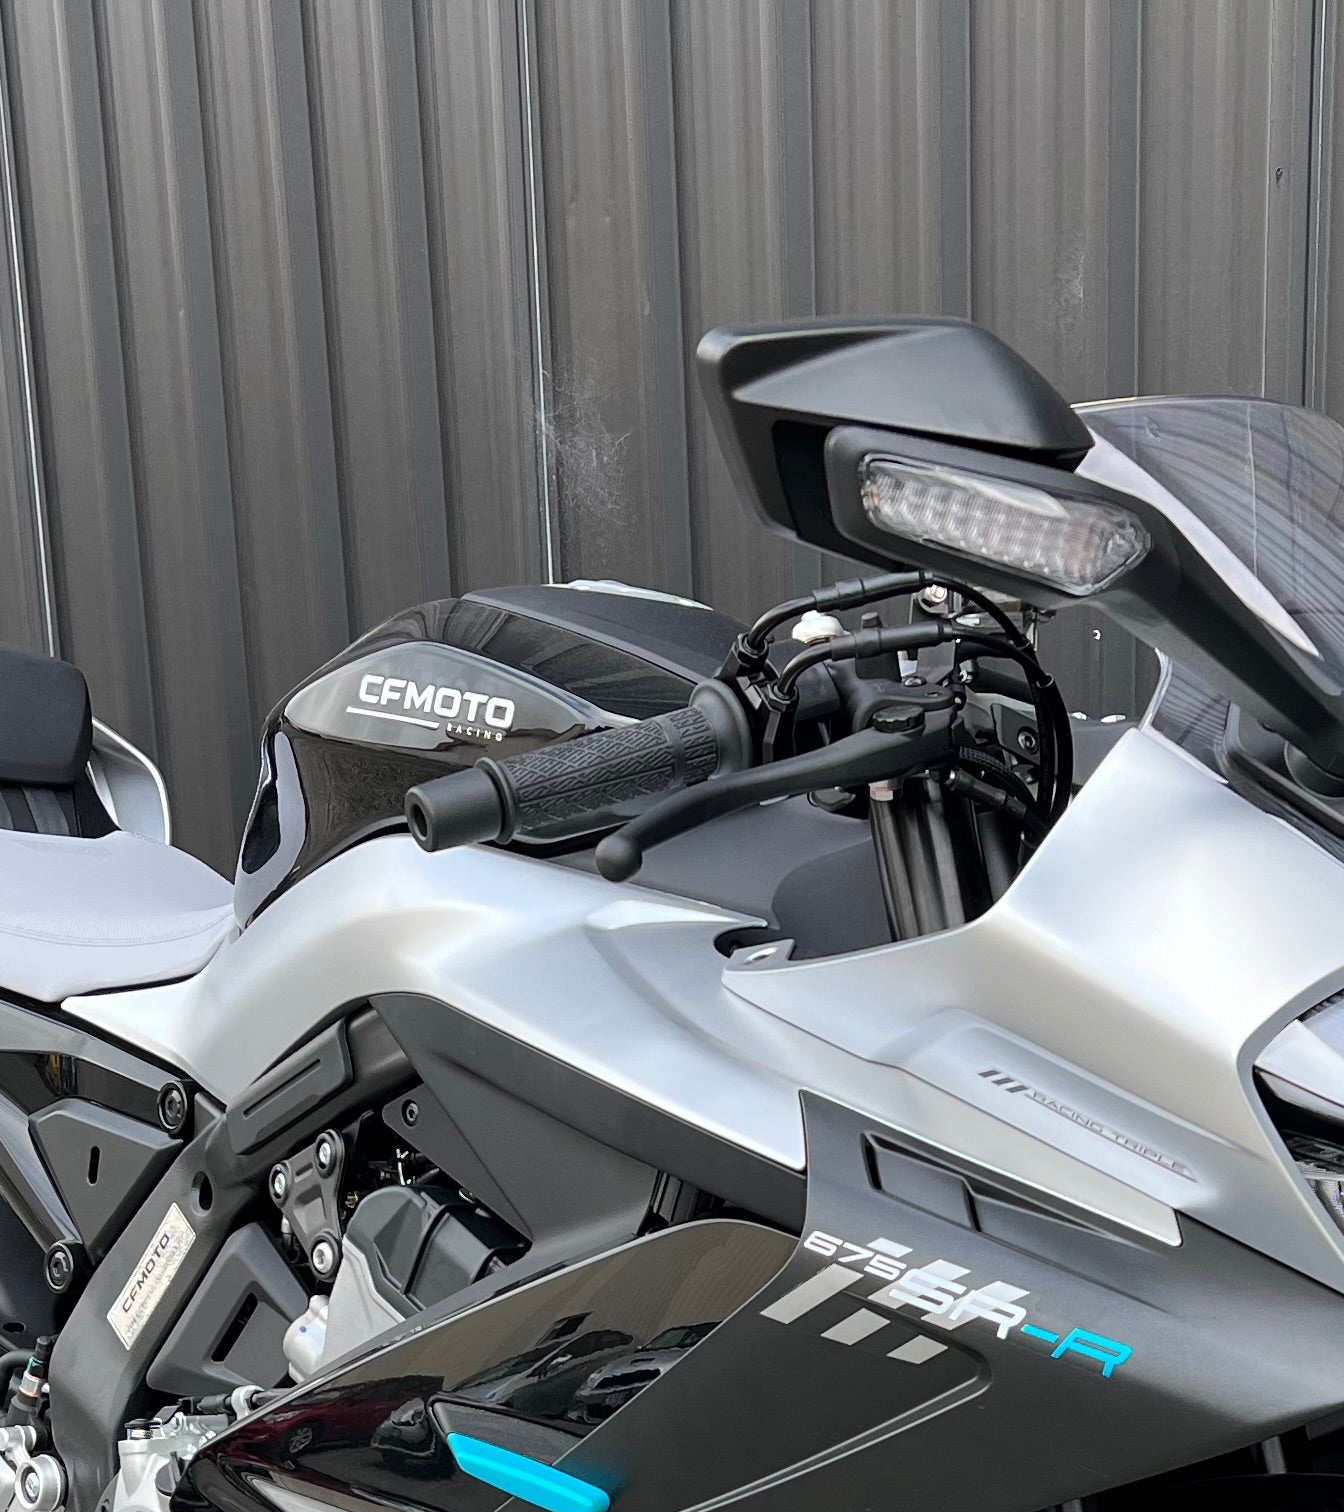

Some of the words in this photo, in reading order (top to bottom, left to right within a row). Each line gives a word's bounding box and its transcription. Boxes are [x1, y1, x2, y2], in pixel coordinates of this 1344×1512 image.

[359, 674, 516, 729] CFMOTO
[446, 723, 504, 743] RACING
[1026, 1088, 1105, 1134] RACING
[1112, 1131, 1195, 1172] TRIPLE
[122, 1232, 170, 1313] CFMOTO
[803, 1229, 908, 1282] 675
